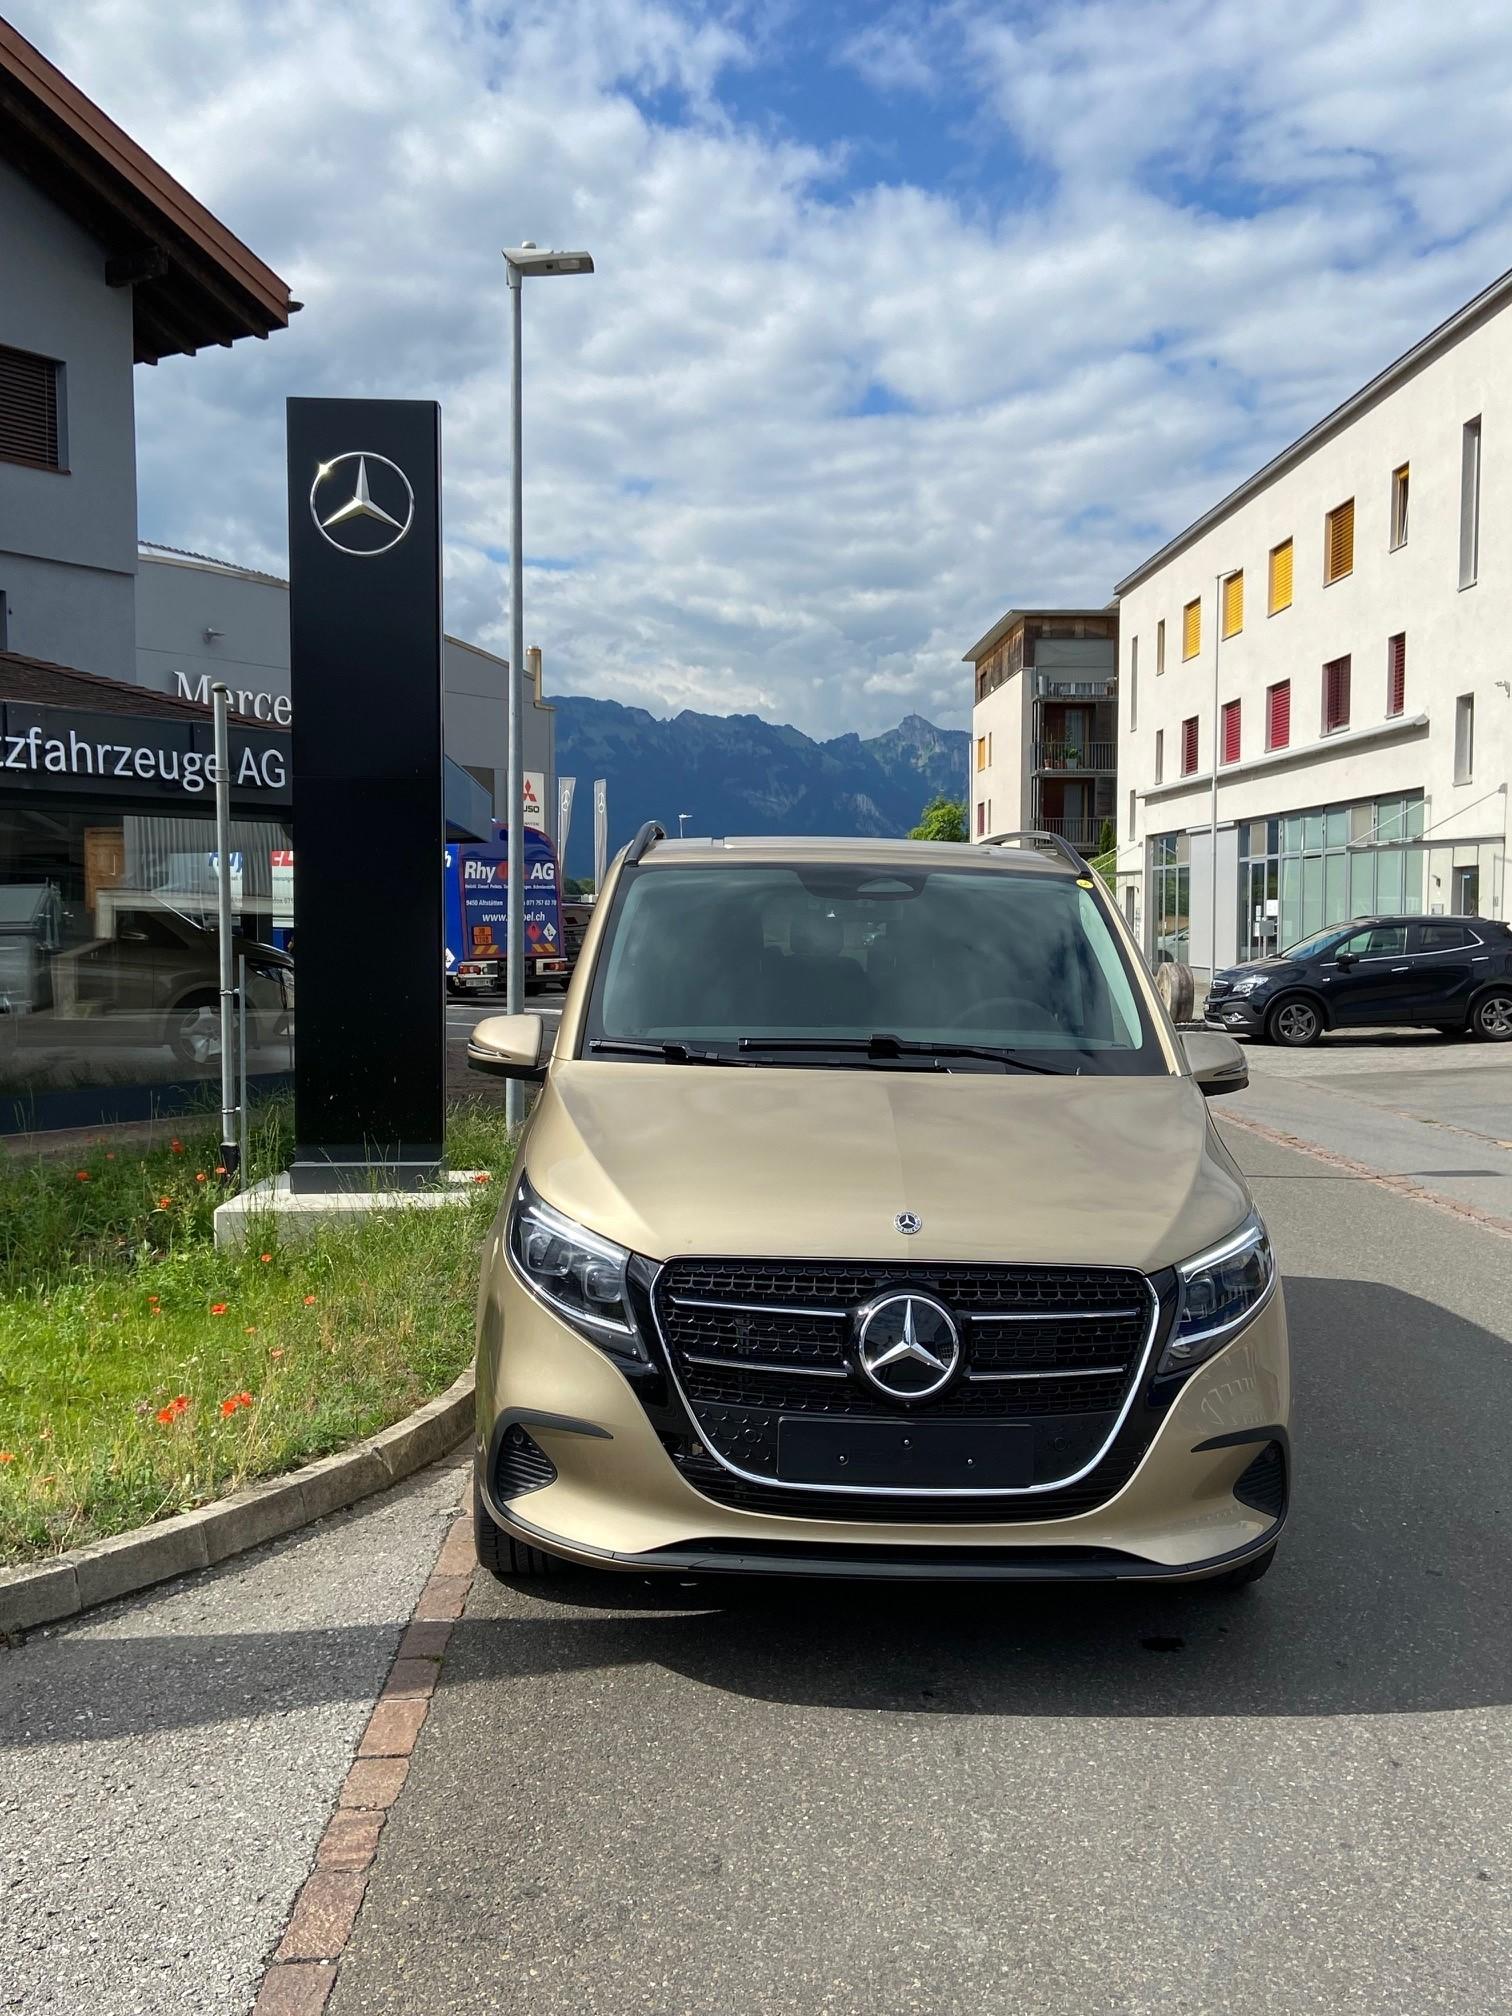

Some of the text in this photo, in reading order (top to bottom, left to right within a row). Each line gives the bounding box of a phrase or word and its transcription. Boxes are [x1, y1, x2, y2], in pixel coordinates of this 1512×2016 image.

[238, 747, 286, 788] AG
[523, 805, 540, 813] USO
[464, 861, 496, 883] Rhy
[530, 862, 555, 880] AG
